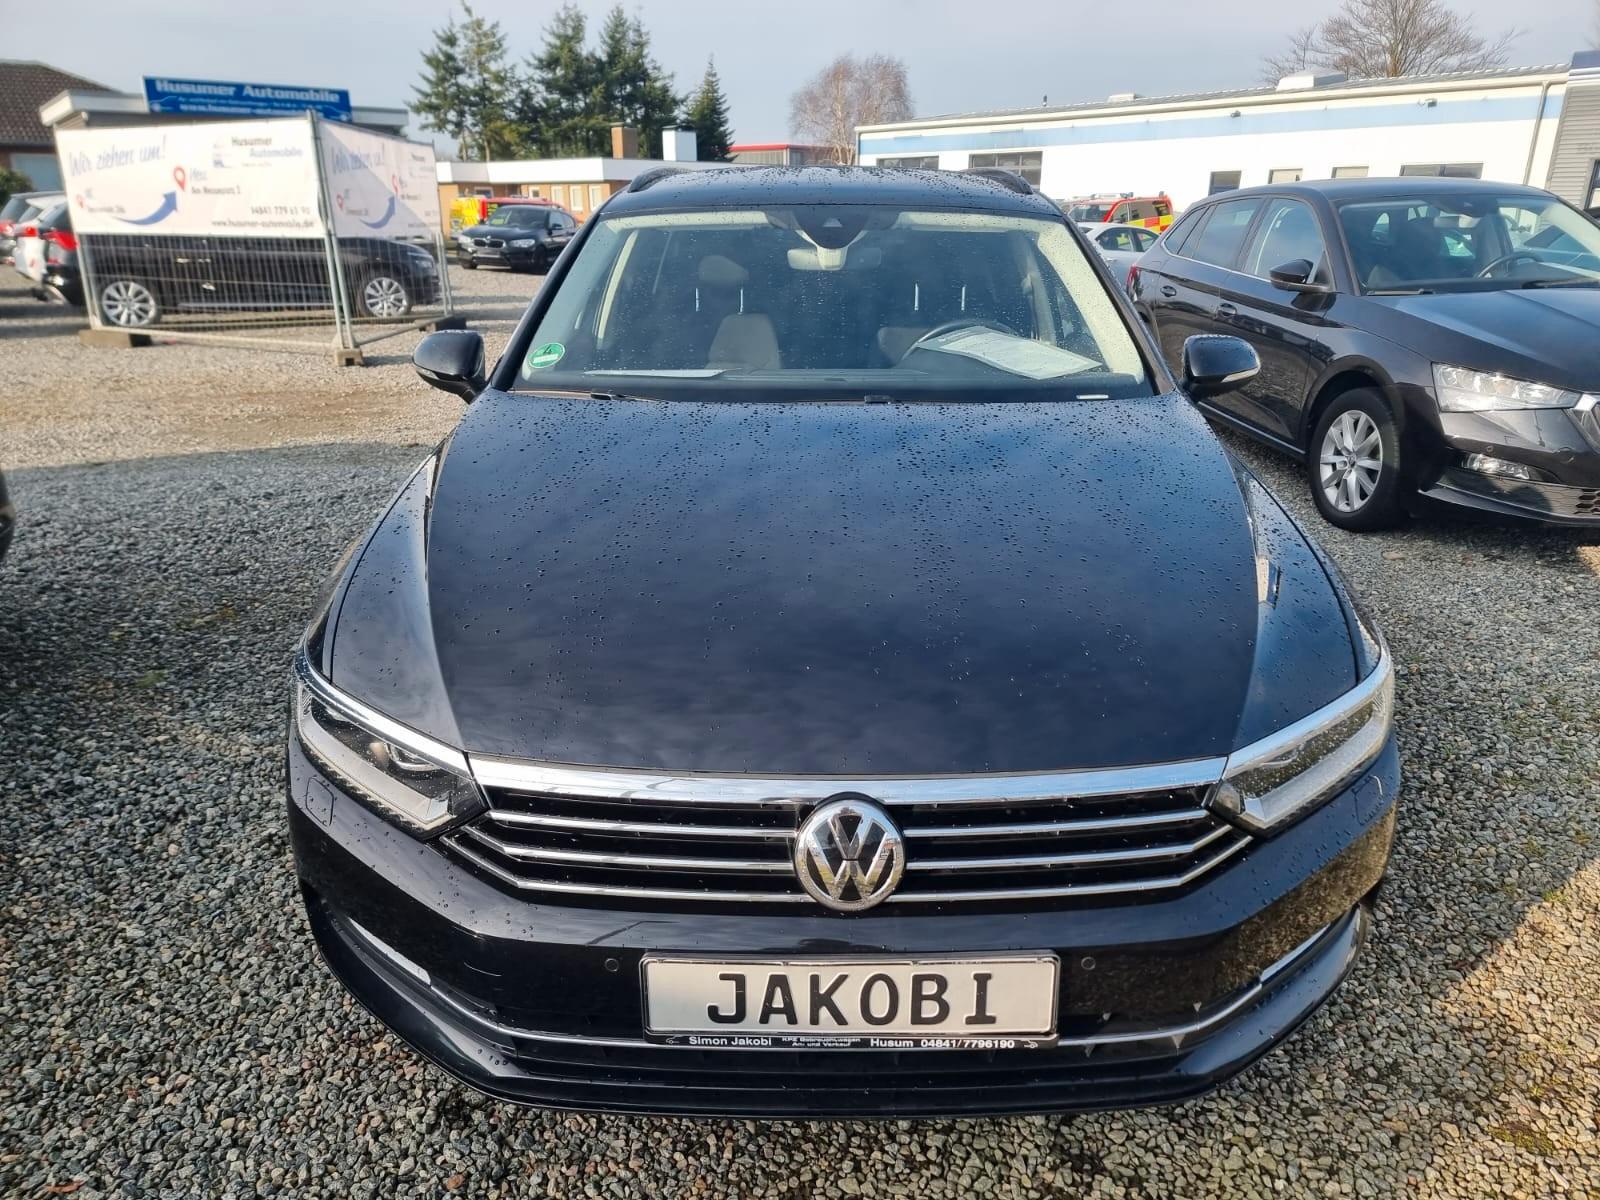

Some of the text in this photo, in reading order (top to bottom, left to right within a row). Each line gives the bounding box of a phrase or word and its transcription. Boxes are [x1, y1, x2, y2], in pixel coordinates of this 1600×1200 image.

[156, 80, 236, 97] Husumer
[243, 86, 340, 103] Automobile
[231, 136, 272, 146] Husumer
[249, 147, 304, 158] Automobile
[69, 152, 92, 176] Wir
[96, 145, 134, 170] ziehen
[707, 972, 997, 1026] JAKOBI
[689, 1036, 772, 1047] Simon Jakobi
[870, 1038, 1015, 1049] Husum 04841/7796190
